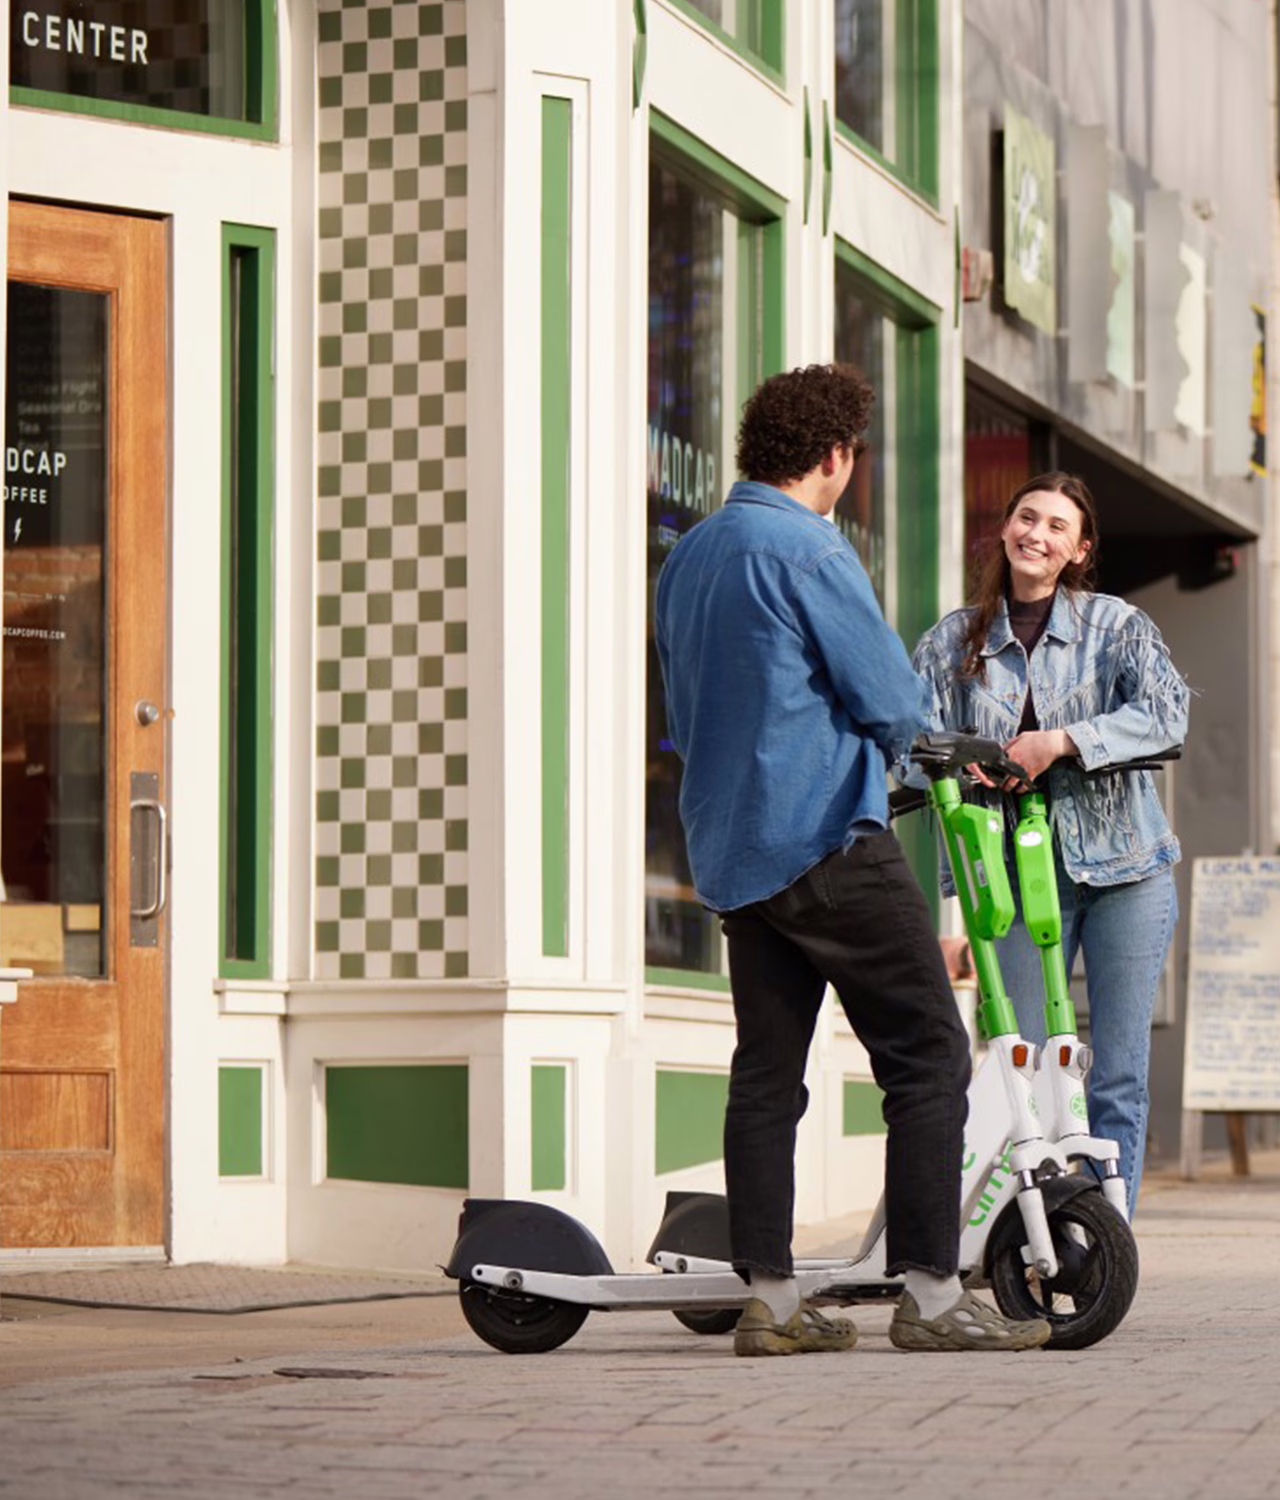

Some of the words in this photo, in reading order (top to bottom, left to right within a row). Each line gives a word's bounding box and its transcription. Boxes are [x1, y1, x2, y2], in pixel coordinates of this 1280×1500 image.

[22, 11, 149, 65] CENTER
[7, 447, 67, 476] DCAP
[648, 423, 716, 514] MADCAP
